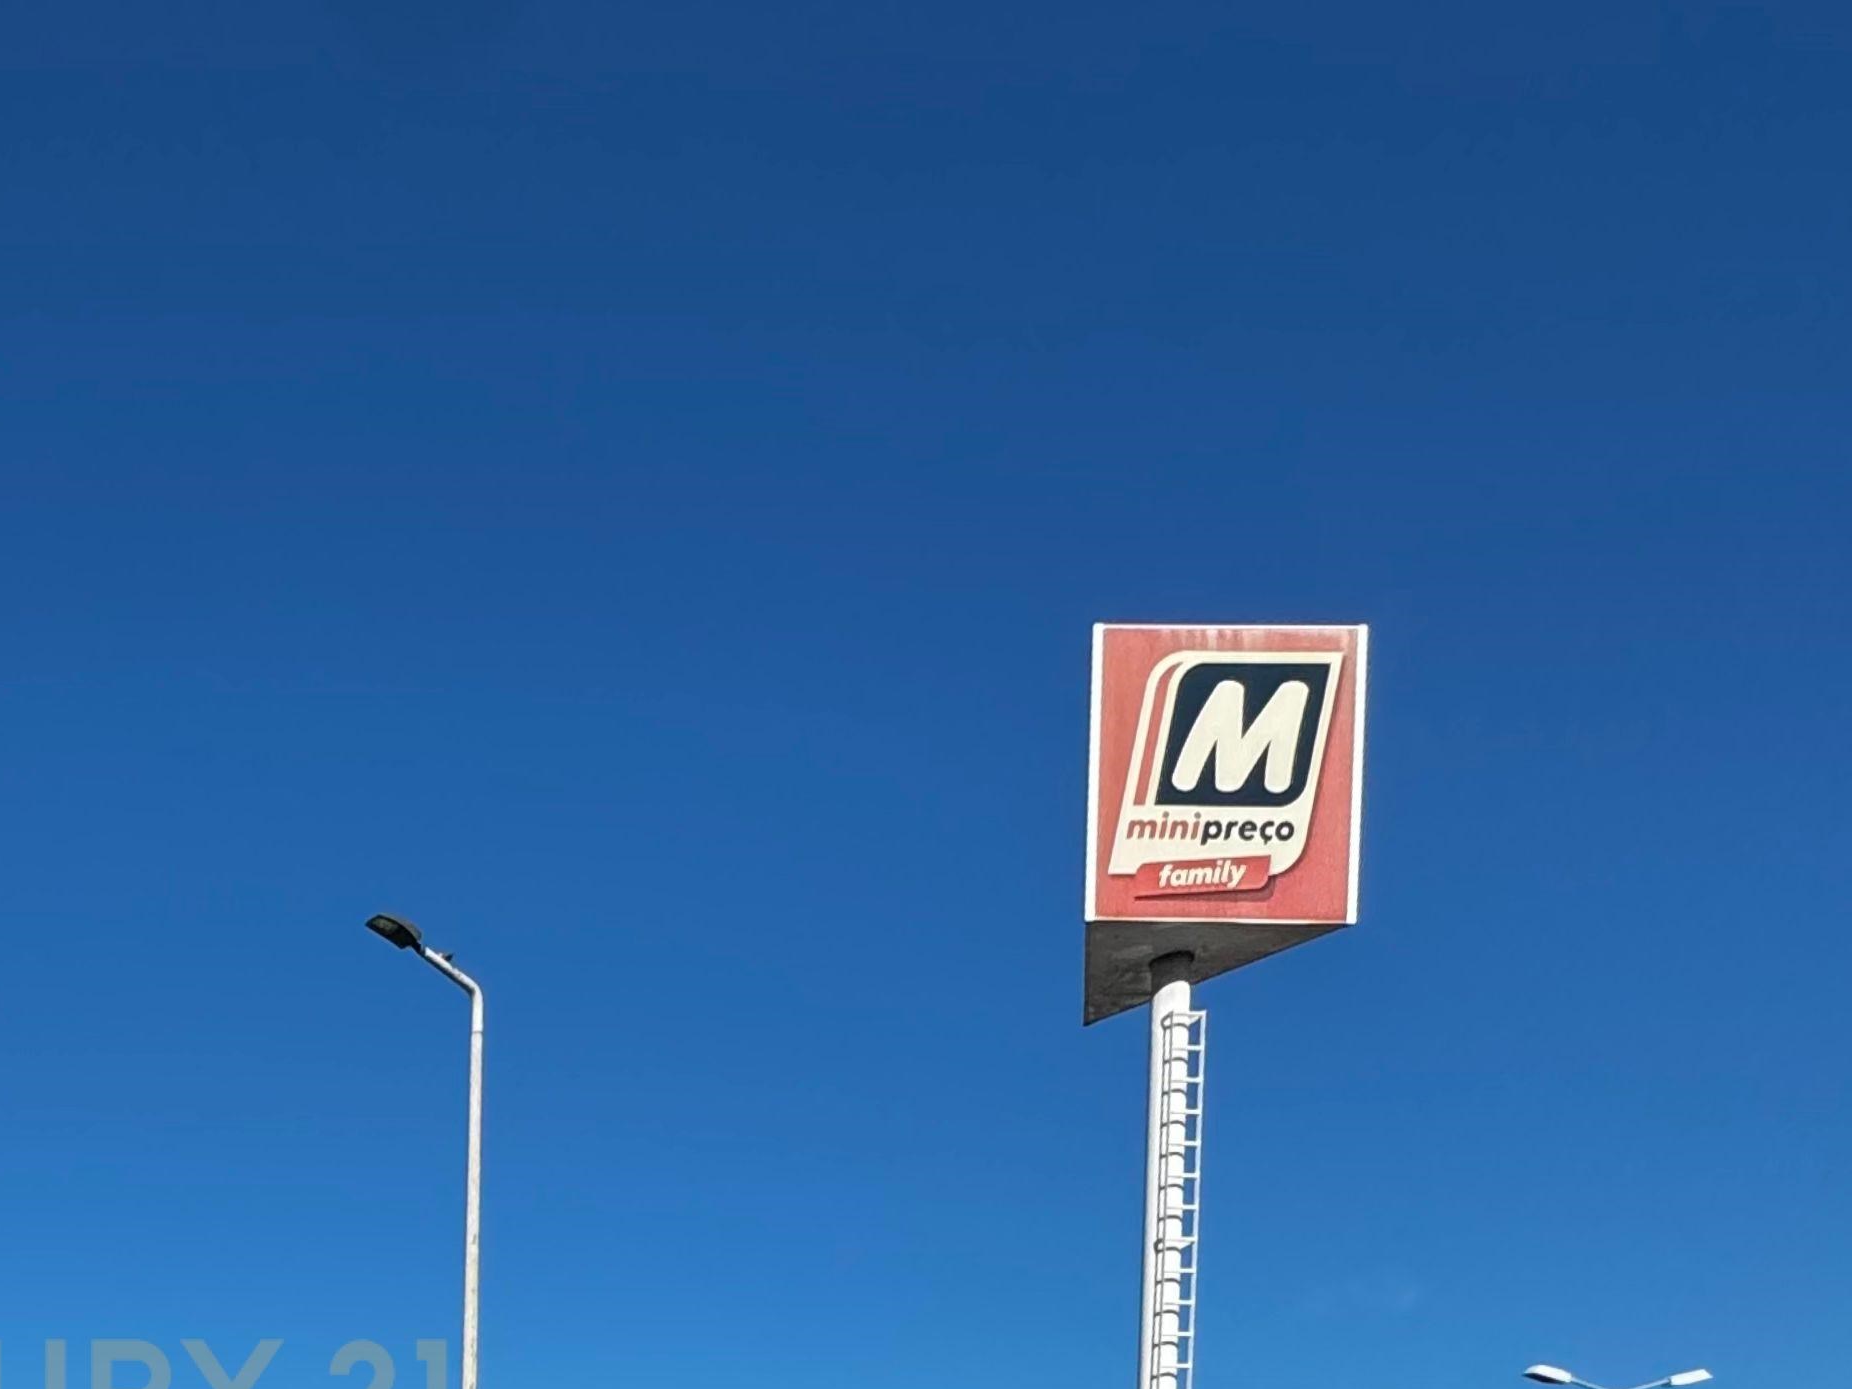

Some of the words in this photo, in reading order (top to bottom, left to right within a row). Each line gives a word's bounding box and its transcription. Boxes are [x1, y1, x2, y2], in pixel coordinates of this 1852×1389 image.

[1171, 680, 1310, 793] M
[1126, 811, 1295, 845] minipreço
[1158, 859, 1247, 889] family
